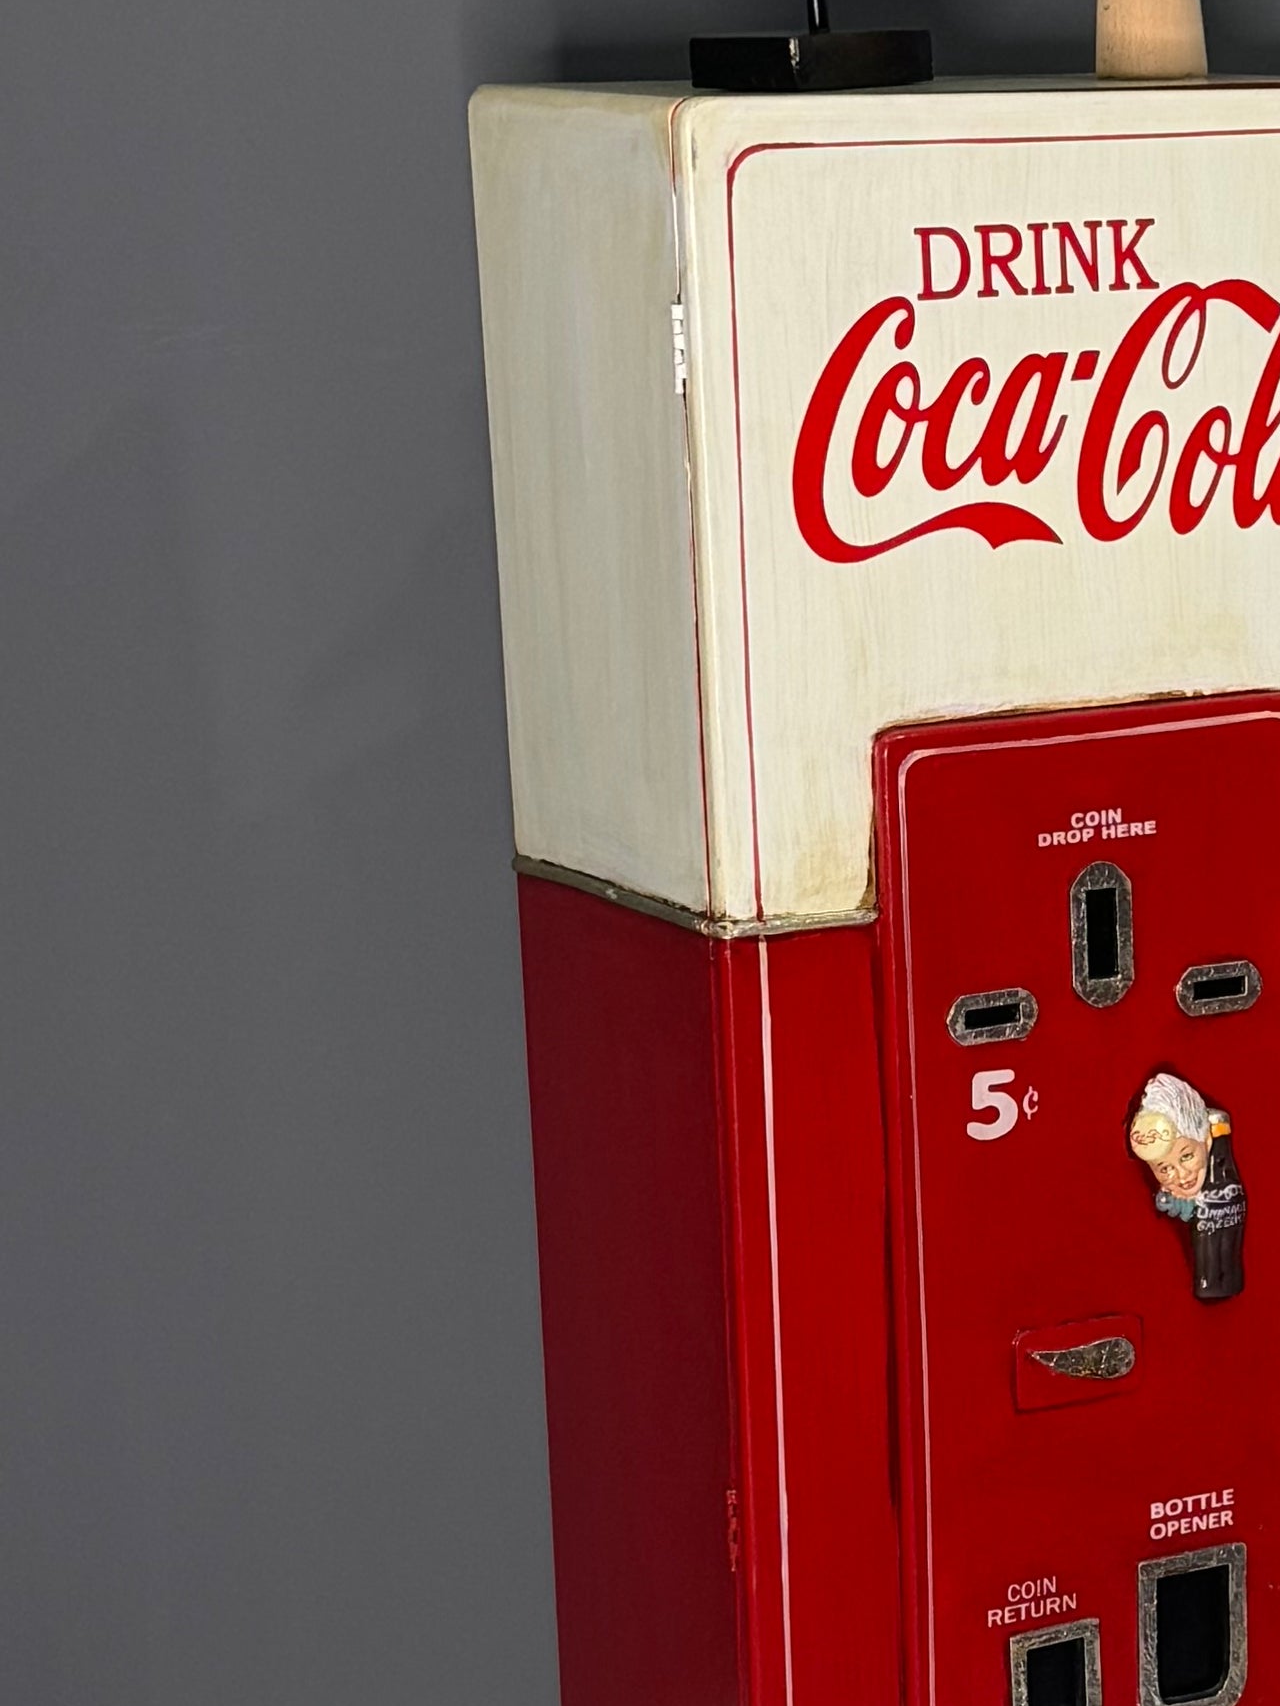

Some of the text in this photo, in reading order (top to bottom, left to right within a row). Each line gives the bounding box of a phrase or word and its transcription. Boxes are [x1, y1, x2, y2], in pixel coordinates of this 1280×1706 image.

[913, 218, 1160, 300] DRINK
[1070, 808, 1122, 828] COIN
[1037, 820, 1157, 847] DROP HERE
[1150, 1488, 1235, 1520] BOTTLE
[1150, 1510, 1234, 1540] OPENER
[1007, 1576, 1057, 1602] COIN
[987, 1593, 1077, 1628] RETURN
